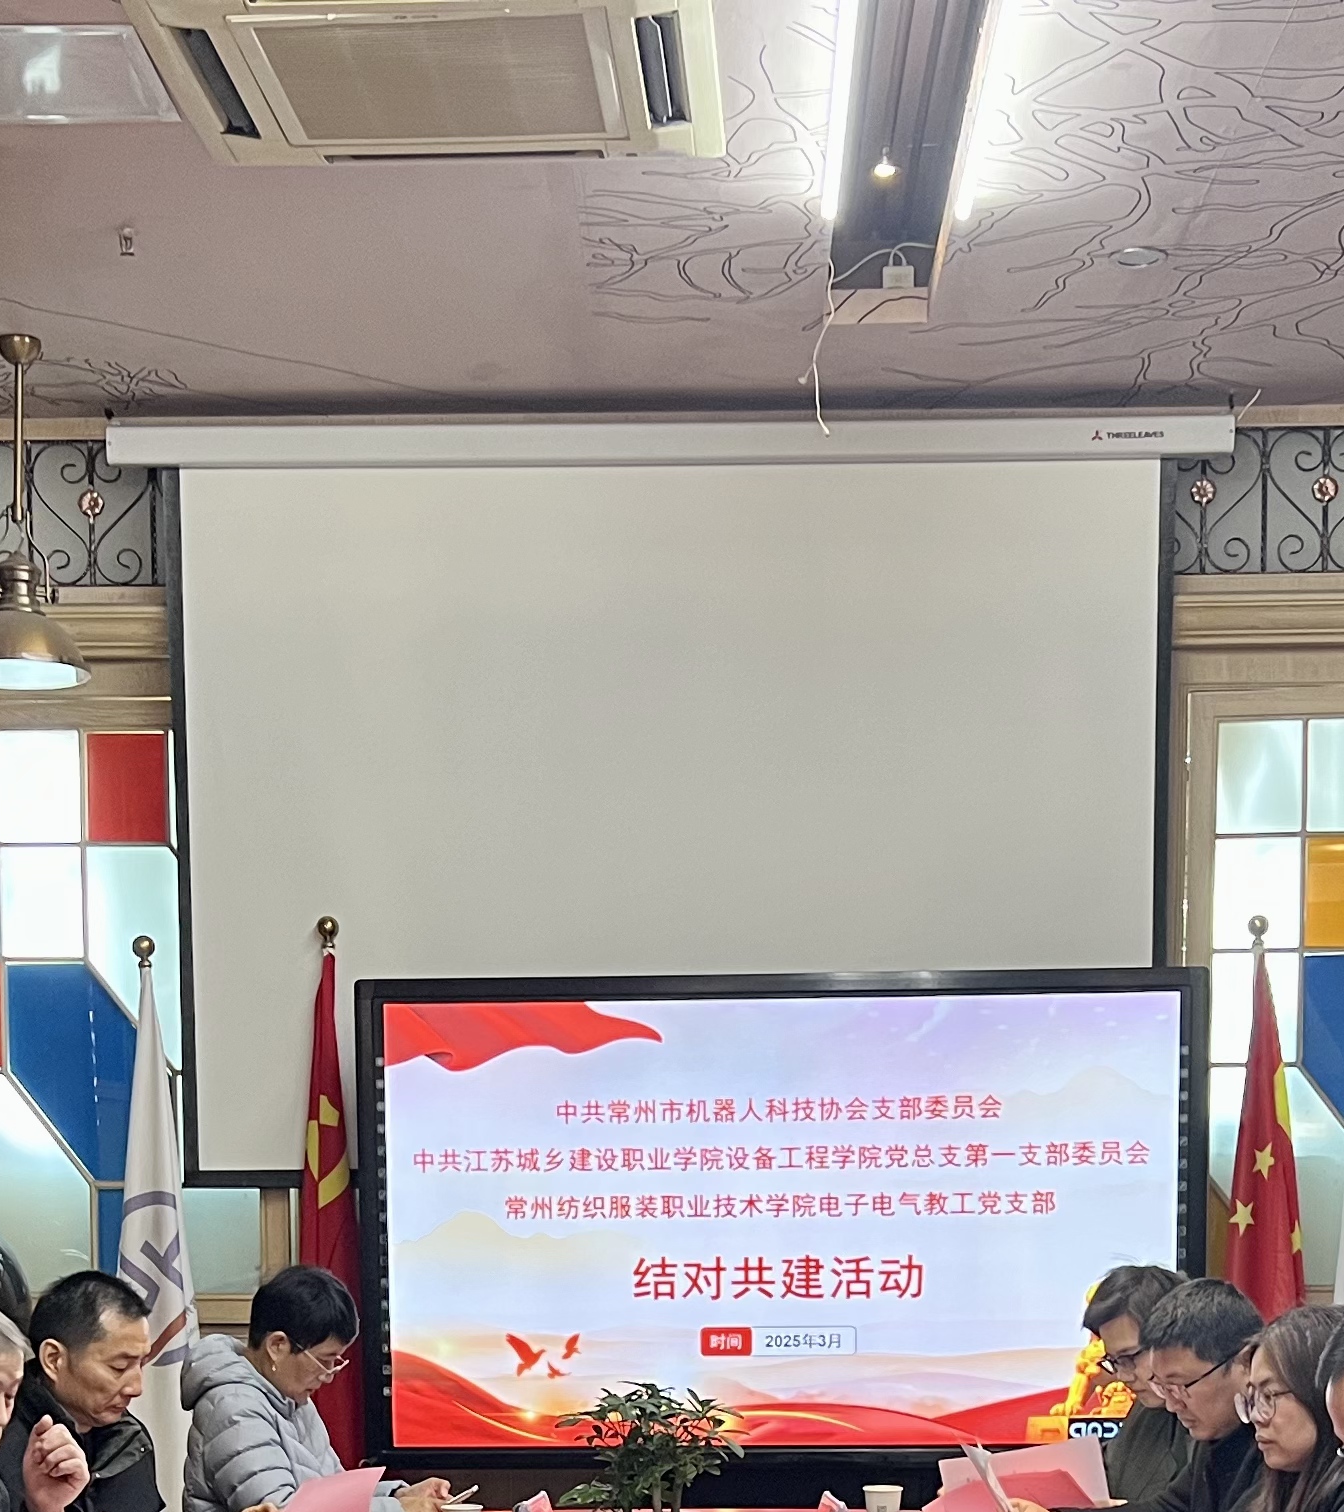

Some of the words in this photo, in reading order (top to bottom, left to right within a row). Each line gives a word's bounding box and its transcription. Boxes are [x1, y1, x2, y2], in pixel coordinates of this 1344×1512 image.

[556, 1094, 1003, 1125] 中共常州市机器人科技协会支部委员会
[412, 1140, 1150, 1174] 中共江苏城乡建设职业学院设备工程学院党总支第一支部委员会
[505, 1190, 1056, 1220] 常州纺织服装职业技术学院电子电气教工党支部
[632, 1254, 923, 1301] 结对共建活动
[709, 1332, 743, 1351] 时间
[764, 1333, 842, 1349] 2025年3月
